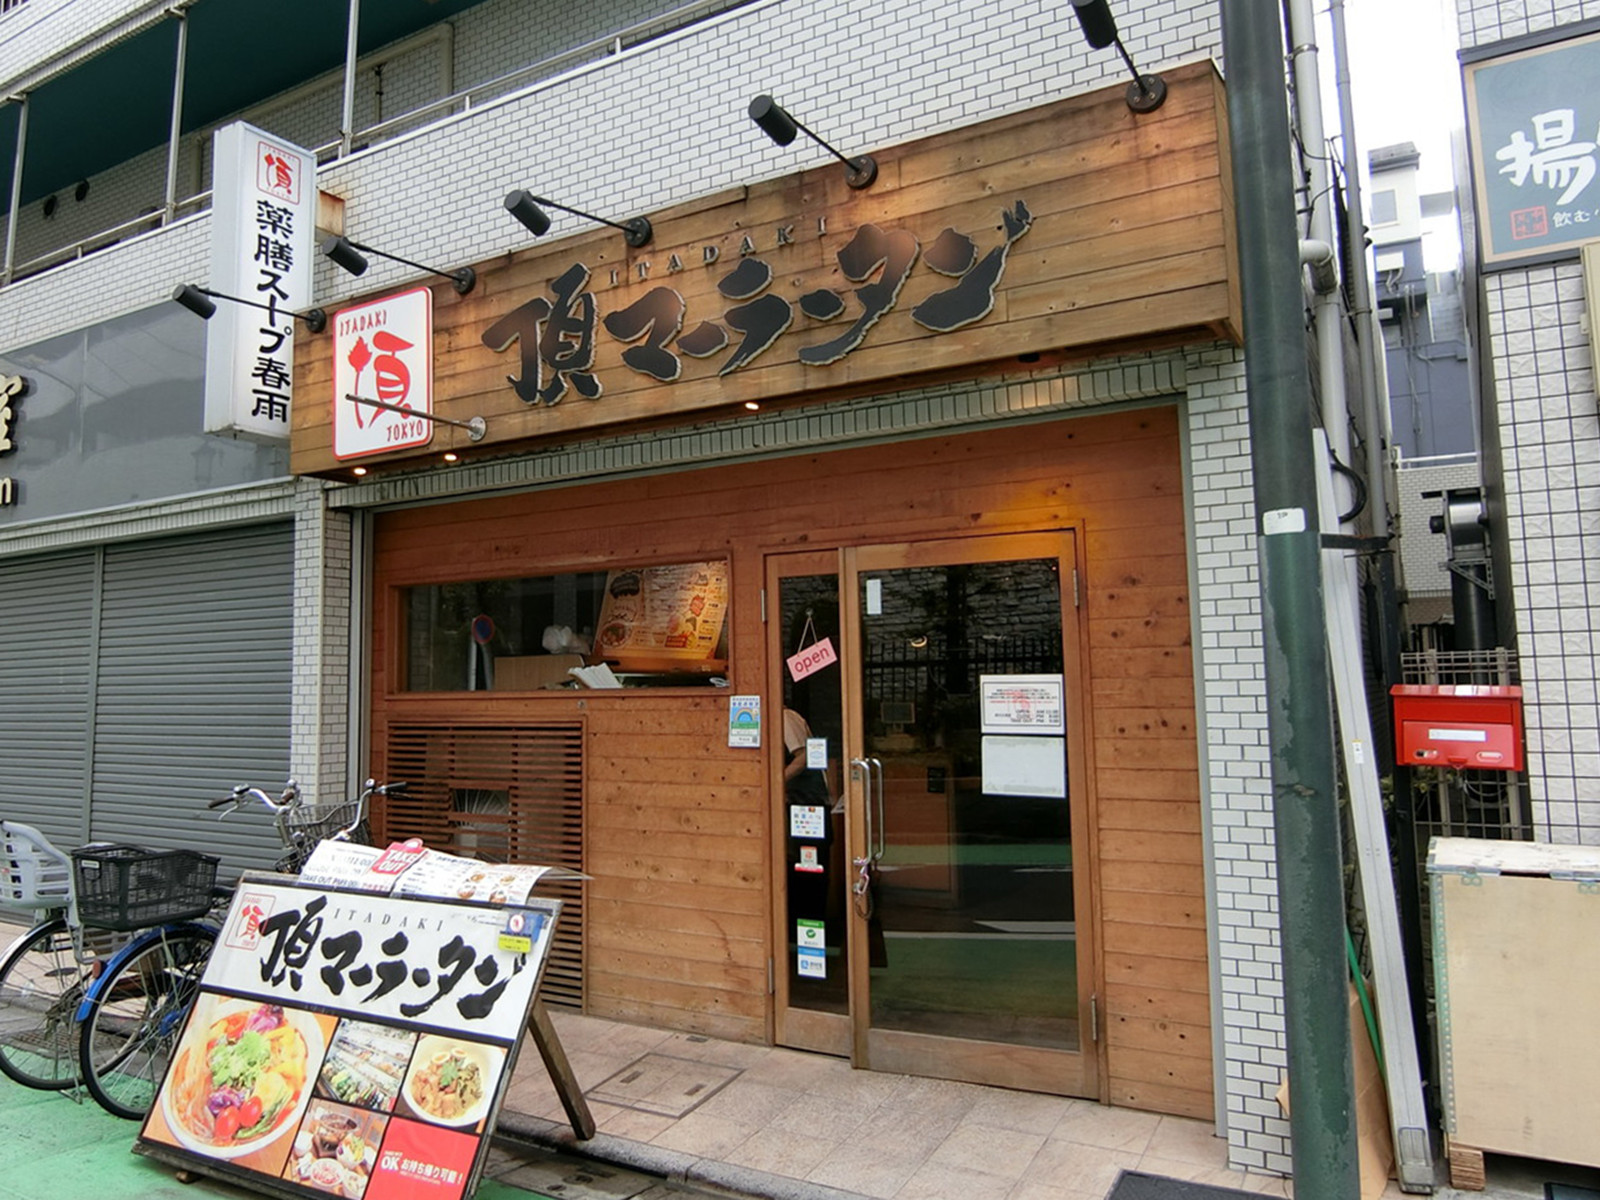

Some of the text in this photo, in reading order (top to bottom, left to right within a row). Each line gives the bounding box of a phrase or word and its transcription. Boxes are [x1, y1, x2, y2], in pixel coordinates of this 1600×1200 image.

[1496, 108, 1600, 206] 揚
[608, 215, 829, 287] ITADAKI
[251, 200, 294, 423] 薬膳スープ春雨
[340, 309, 388, 337] ITADAKI
[386, 419, 424, 442] TOKYO
[794, 647, 830, 673] open
[380, 862, 405, 873] OUT
[385, 849, 418, 862] TAKE
[333, 908, 444, 932] ITADAKI
[381, 1156, 400, 1171] OK
